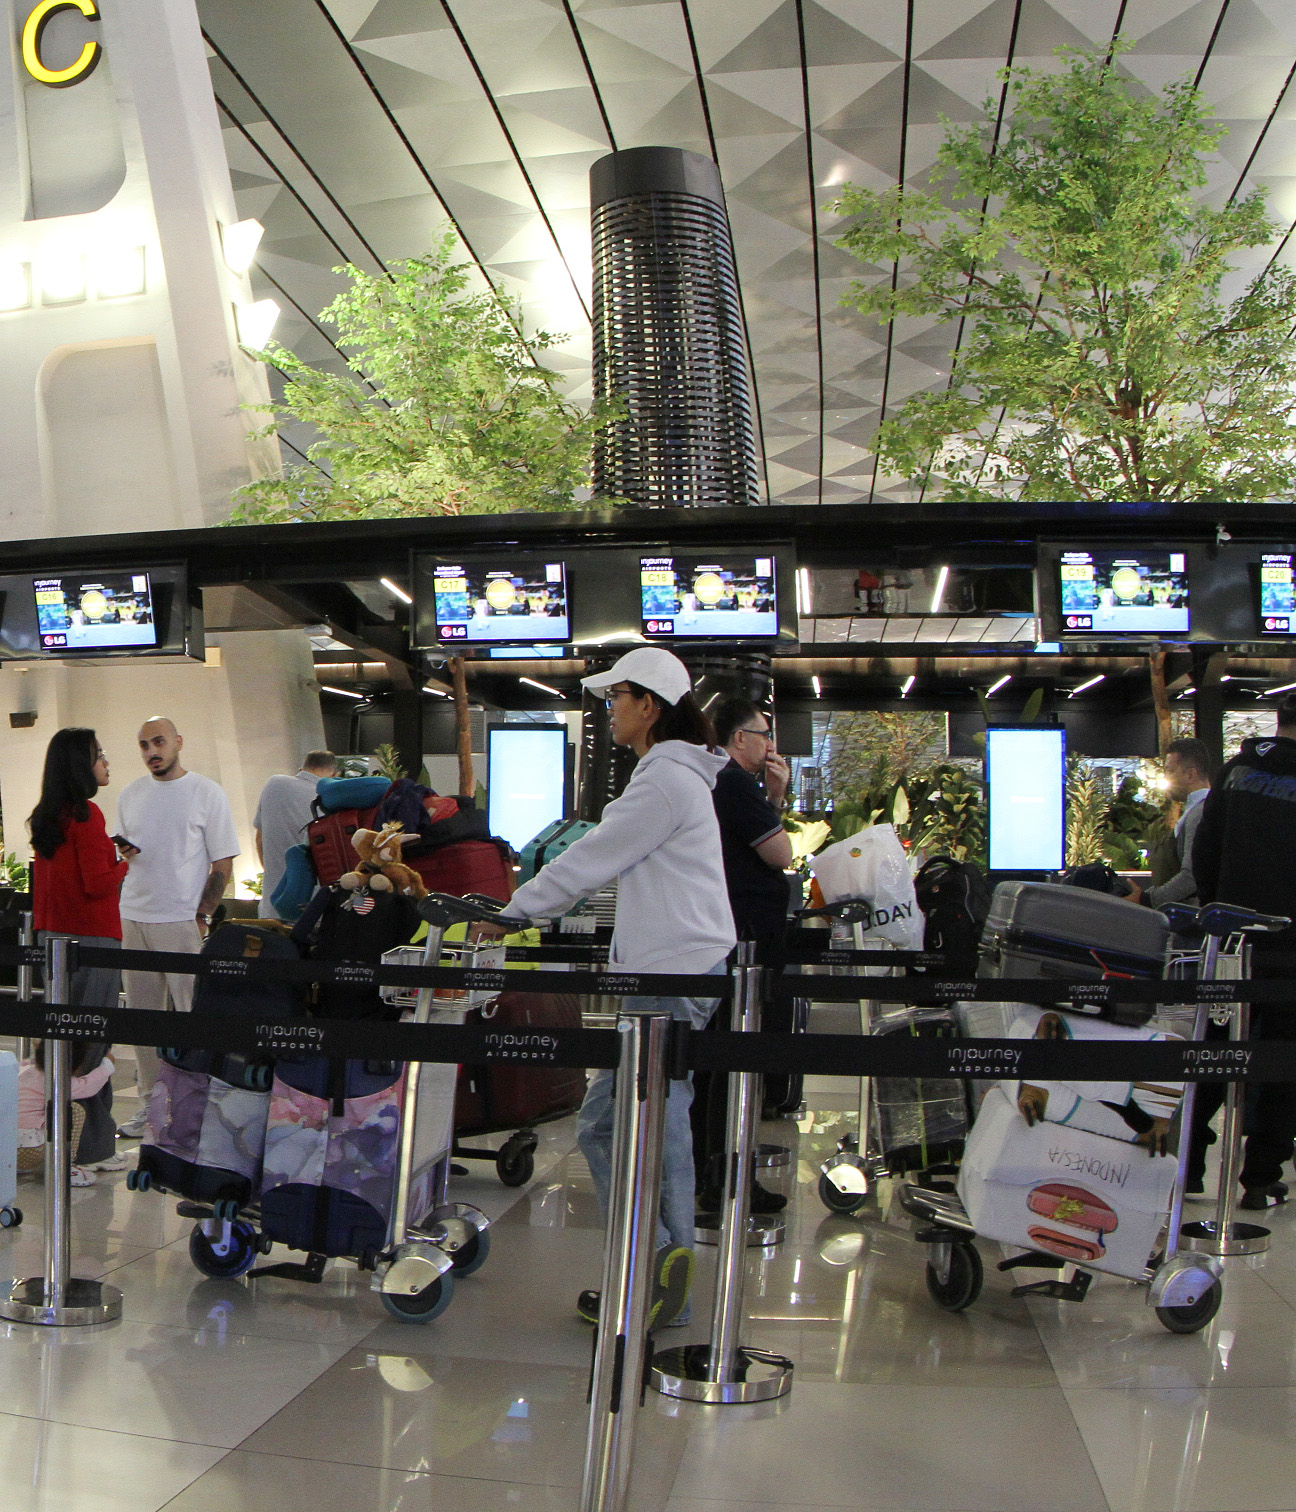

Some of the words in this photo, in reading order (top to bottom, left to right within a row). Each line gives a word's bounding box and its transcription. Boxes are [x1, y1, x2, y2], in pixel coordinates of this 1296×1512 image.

[22, 0, 100, 86] C
[1068, 568, 1086, 577] C19
[1267, 570, 1285, 579] C20
[647, 574, 667, 582] C18
[440, 580, 459, 589] C17
[658, 621, 673, 631] LG
[1077, 617, 1092, 627] LG
[1275, 619, 1289, 629] LG
[452, 627, 466, 636] LG
[53, 636, 66, 645] LG
[209, 959, 248, 970] injourney
[334, 966, 375, 977] injourney
[464, 972, 506, 983] injourney
[934, 982, 978, 993] injourney
[1068, 984, 1111, 995] injourney
[45, 1012, 108, 1028] injourney
[46, 1028, 105, 1037] AIRPORTS
[255, 1024, 325, 1041] injourney
[257, 1041, 321, 1051] AIRPORTS
[485, 1033, 559, 1051] injourney
[486, 1051, 555, 1060] AIRPORTS
[948, 1047, 1022, 1065] injourney
[1182, 1048, 1253, 1065] injourney
[949, 1065, 1018, 1074] AIRPORTS
[1183, 1066, 1248, 1075] AIRPORTS
[1048, 1146, 1131, 1188] INDONESIA
